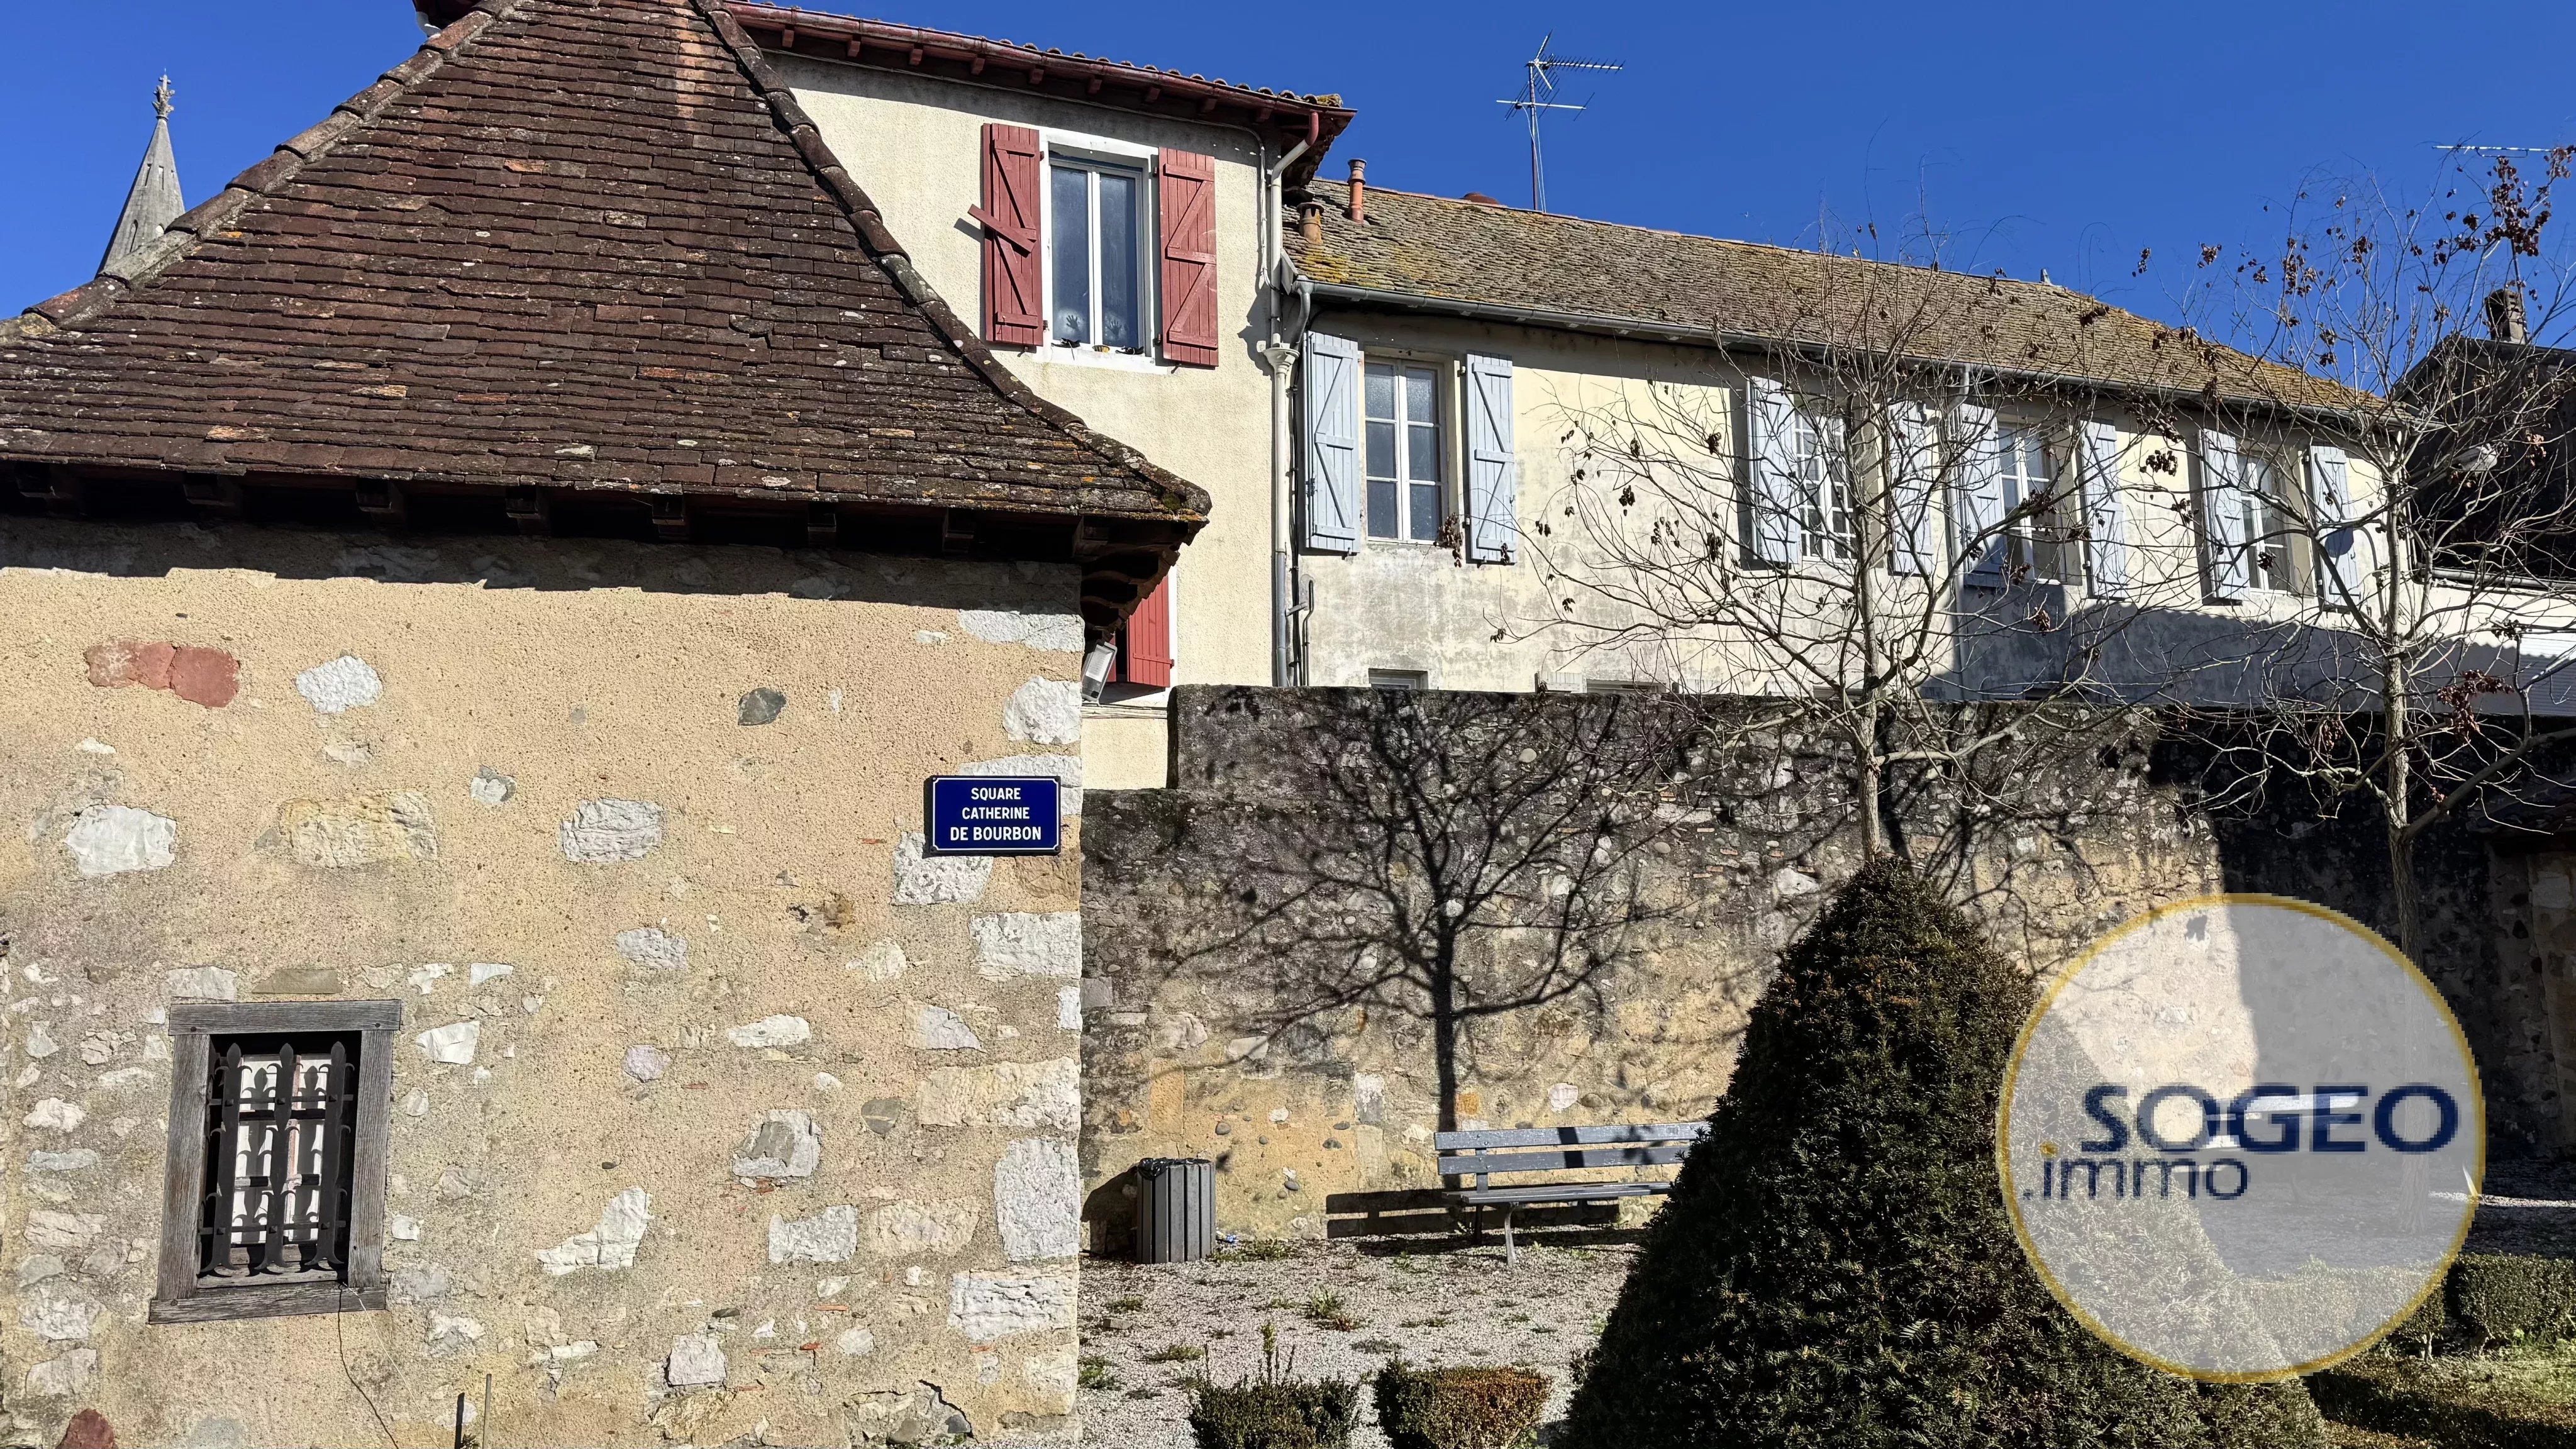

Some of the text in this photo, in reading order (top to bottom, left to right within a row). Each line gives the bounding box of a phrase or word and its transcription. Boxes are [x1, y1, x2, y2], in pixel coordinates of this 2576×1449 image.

[971, 787, 1021, 801] SQUARE
[962, 807, 1030, 819] CATHERINE
[950, 826, 1041, 841] DE BOURBON
